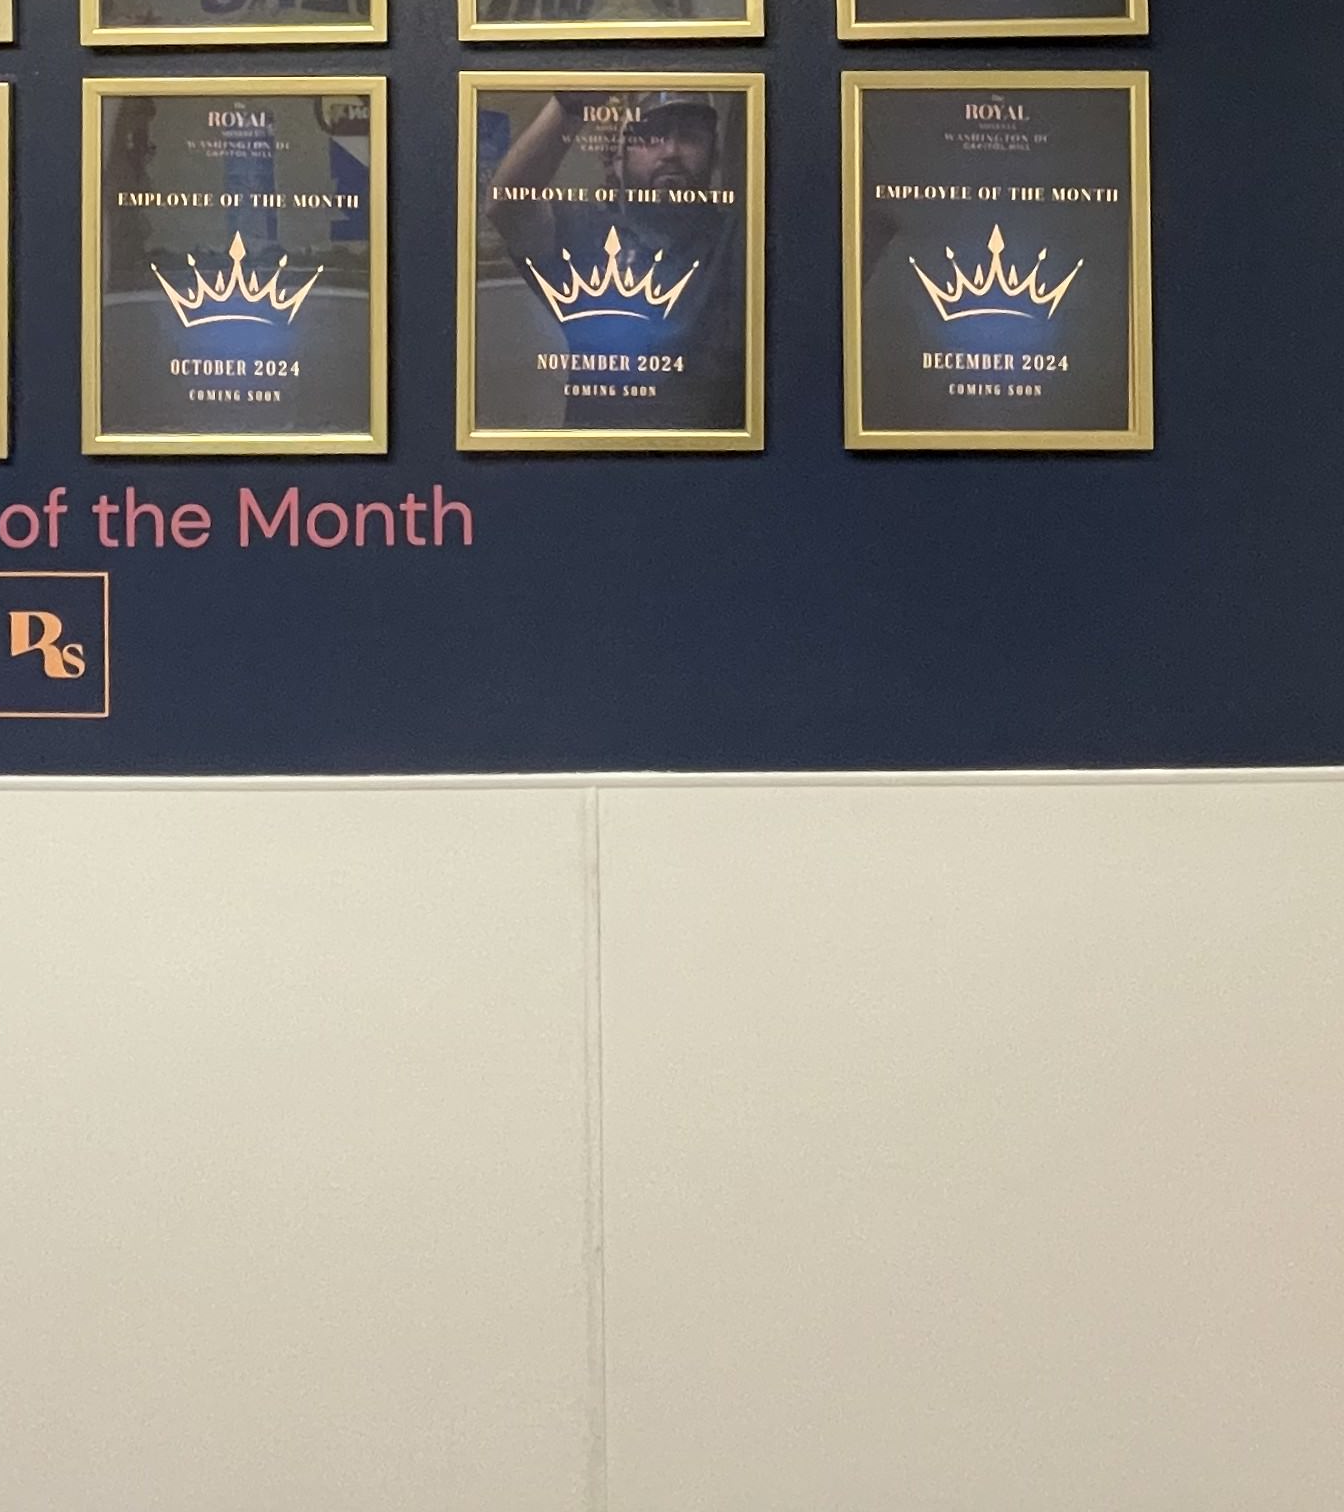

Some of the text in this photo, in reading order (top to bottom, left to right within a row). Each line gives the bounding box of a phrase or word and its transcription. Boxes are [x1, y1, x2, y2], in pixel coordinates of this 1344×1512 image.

[207, 111, 272, 128] ROYAL
[583, 106, 647, 122] ROYAL
[965, 104, 1030, 120] ROYAL
[118, 193, 358, 208] EMPLOYEE OF THE MONTH
[493, 187, 734, 203] EMPLOYEE OF THE MONTH
[876, 186, 1117, 201] EMPLOYEE OF THE MONTH
[171, 359, 299, 376] OCTOBER 2024
[538, 354, 683, 371] NOVEMBER 2024
[923, 353, 1068, 371] DECEMBER 2024
[189, 390, 280, 401] COMING SOON
[564, 385, 656, 396] COMING SOON
[949, 384, 1041, 395] COMING SOON
[92, 487, 211, 547] the
[240, 485, 472, 547] Month
